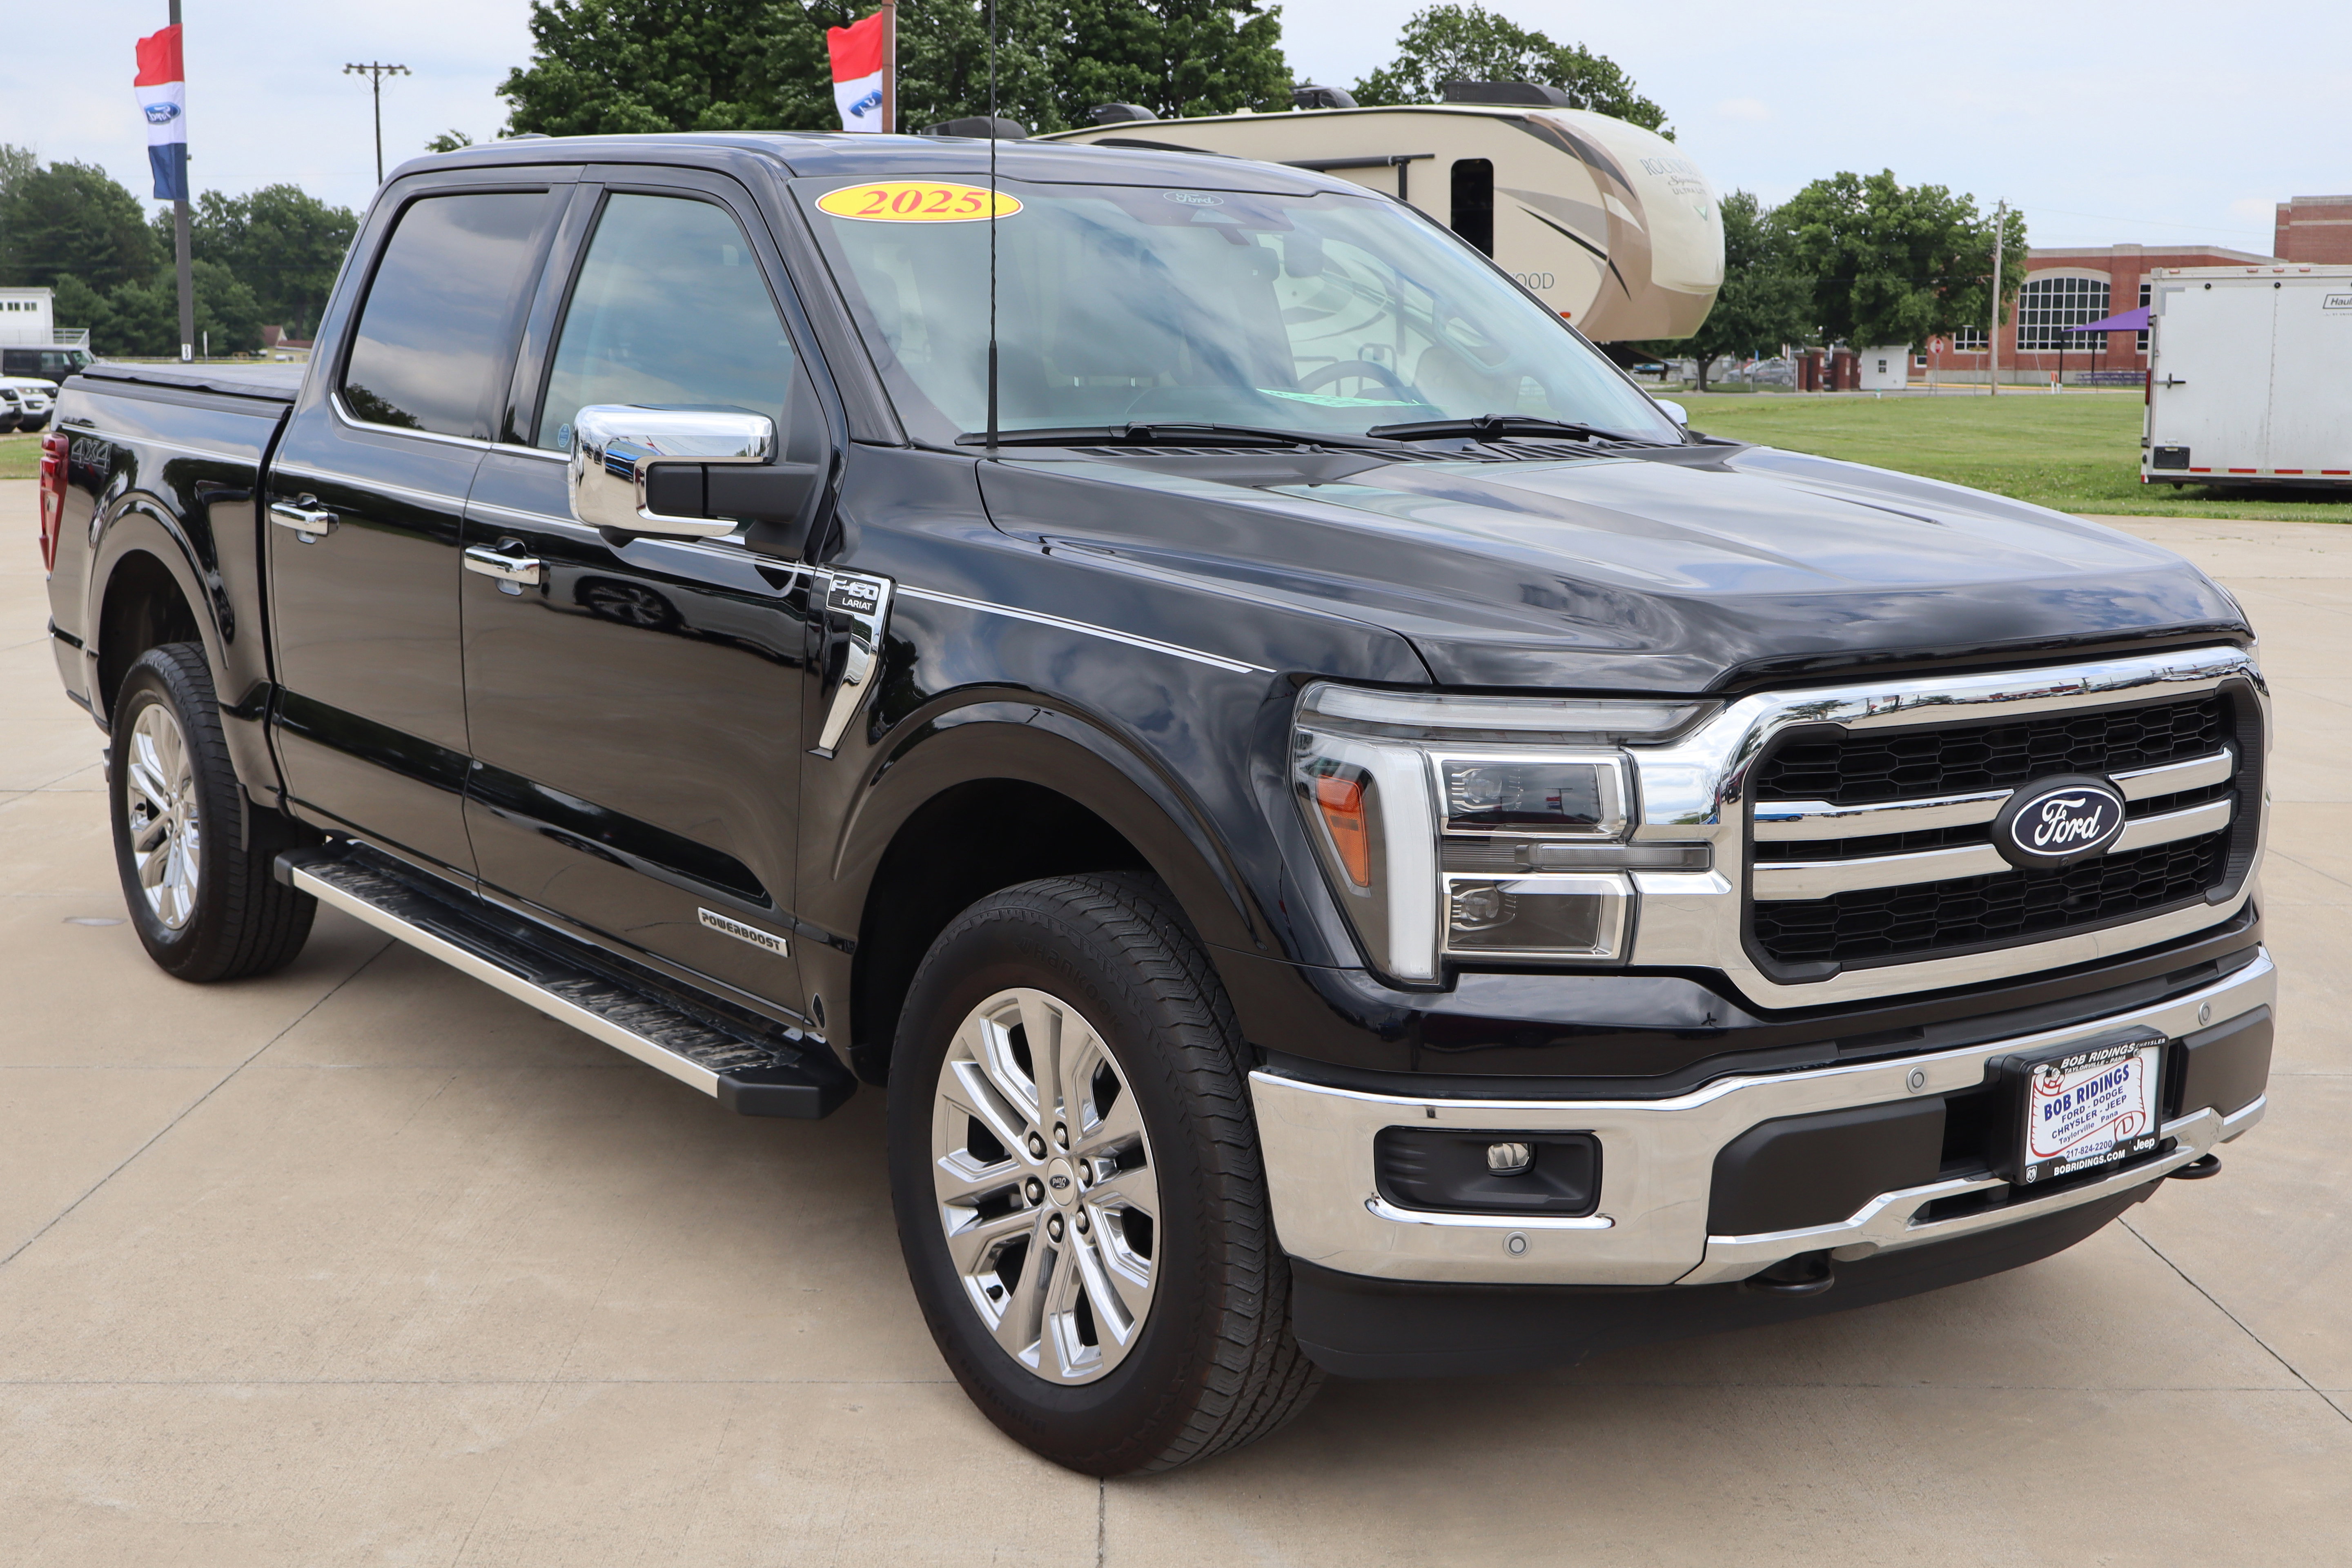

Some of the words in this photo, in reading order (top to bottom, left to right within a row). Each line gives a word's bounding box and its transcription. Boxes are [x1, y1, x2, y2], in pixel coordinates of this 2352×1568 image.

[856, 190, 986, 215] 2025
[1175, 192, 1214, 205] Ford
[1512, 273, 1554, 290] OOD
[831, 579, 879, 601] F-150
[842, 597, 873, 610] LARIAT
[2034, 797, 2102, 846] Ford
[702, 912, 780, 951] POWERBOOST
[2136, 1038, 2165, 1049] CHRYSLER
[2060, 1054, 2087, 1069] BOB
[2087, 1042, 2136, 1063] RIDINGS
[2064, 1061, 2105, 1074] TAYLORVILLE
[2109, 1055, 2127, 1063] PANA
[2044, 1094, 2071, 1122] BOB
[2077, 1064, 2129, 1105] RIDINGS
[2062, 1105, 2085, 1123] FORD
[2094, 1085, 2123, 1107] DODGE
[2052, 1109, 2097, 1139] CHRYSLER
[2105, 1095, 2127, 1111] JEEP
[2059, 1122, 2094, 1145] Taylorville
[2101, 1110, 2118, 1123] Pana
[2066, 1140, 2112, 1158] 217-824-2200
[2134, 1137, 2155, 1151] Jeep
[2054, 1149, 2125, 1176] BOBRIDINGS.COM
[1052, 1177, 1066, 1188] Ford
